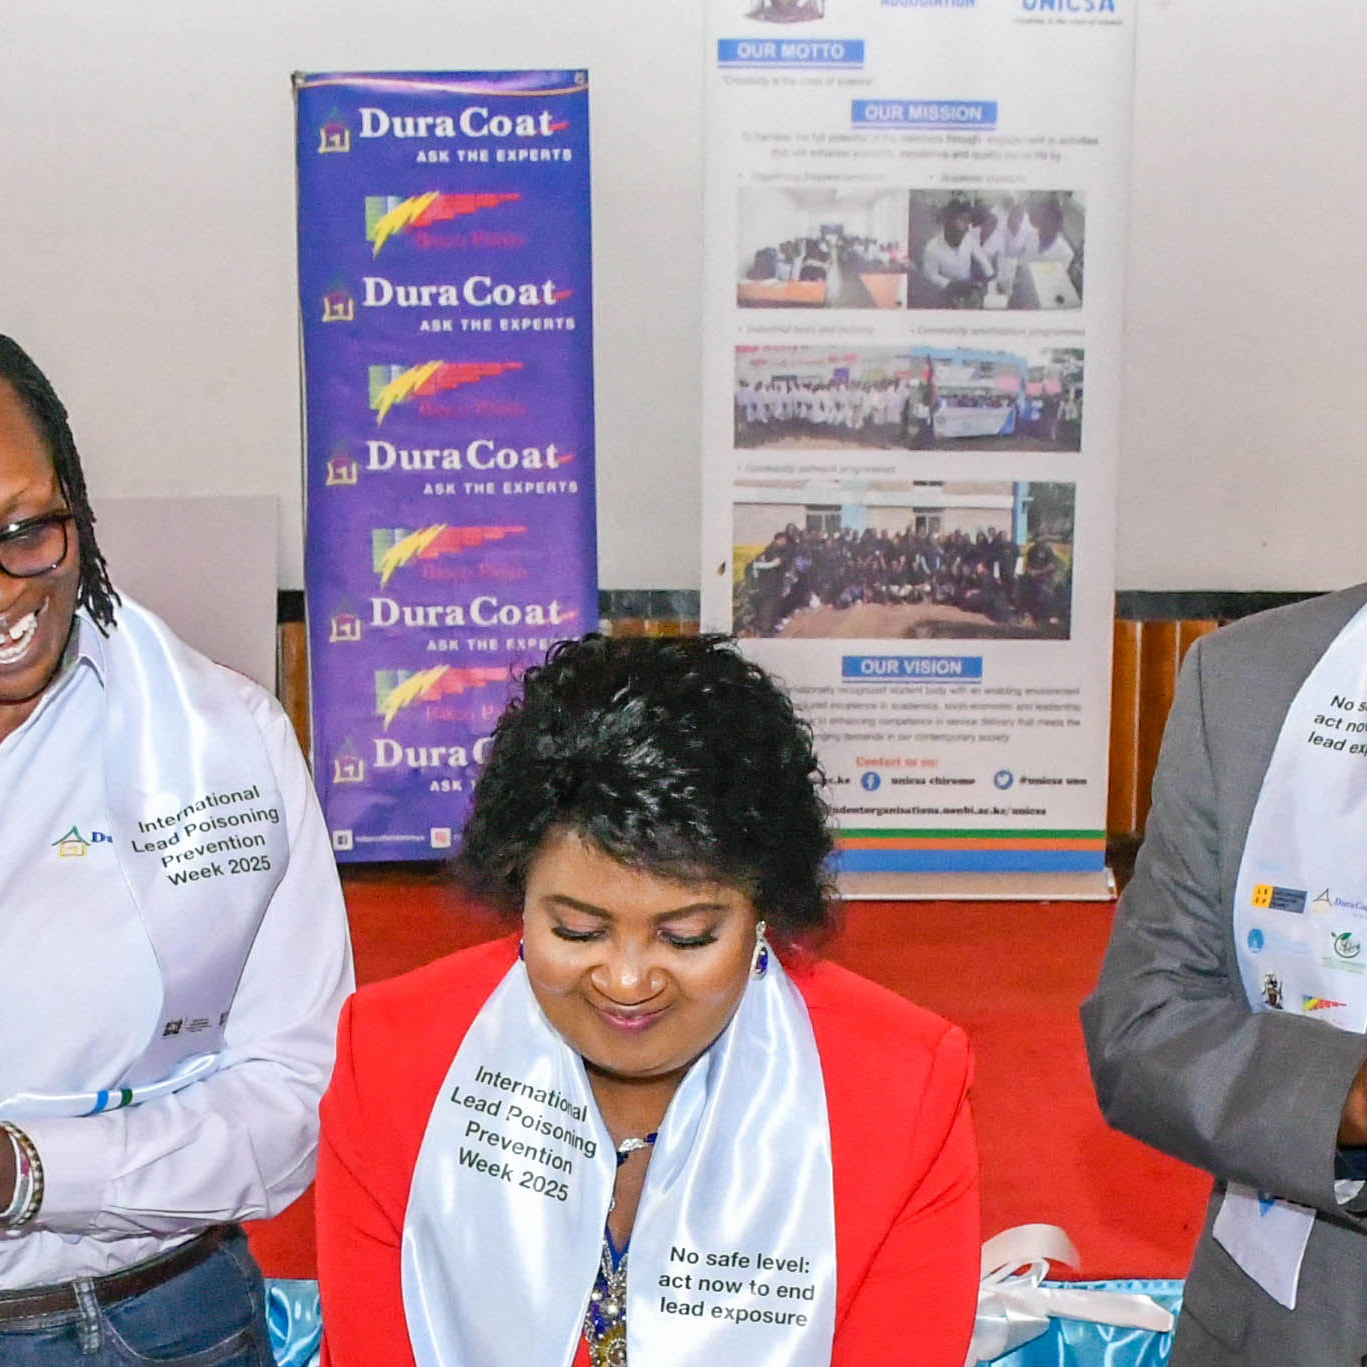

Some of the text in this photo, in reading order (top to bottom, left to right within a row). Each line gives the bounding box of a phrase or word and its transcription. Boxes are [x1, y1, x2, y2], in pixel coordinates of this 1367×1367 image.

[737, 43, 846, 59] OUR MOTTO
[865, 104, 982, 121] OUR MISSION
[417, 149, 572, 163] ASK THE EXPERTS
[420, 318, 575, 332] ASK THE EXPERTS
[424, 480, 577, 495] ASK THE EXPERTS
[427, 640, 459, 651] ASK
[468, 639, 498, 650] THE
[861, 660, 962, 675] OUR VISION
[1330, 695, 1354, 711] No
[1313, 714, 1343, 729] act
[1308, 731, 1347, 751] lead
[430, 780, 462, 791] ASK
[137, 784, 261, 833] International
[131, 807, 280, 853] Lead Poisoning
[201, 832, 266, 869] Prevention
[166, 855, 271, 886] Week 2025
[475, 1065, 587, 1123] International
[450, 1086, 598, 1160] Lead Poisoning
[464, 1120, 573, 1175] Prevention
[457, 1146, 570, 1203] Week 2025
[669, 1245, 810, 1274] No safe level:
[658, 1272, 815, 1302] act now to end
[659, 1296, 809, 1328] lead exposure
